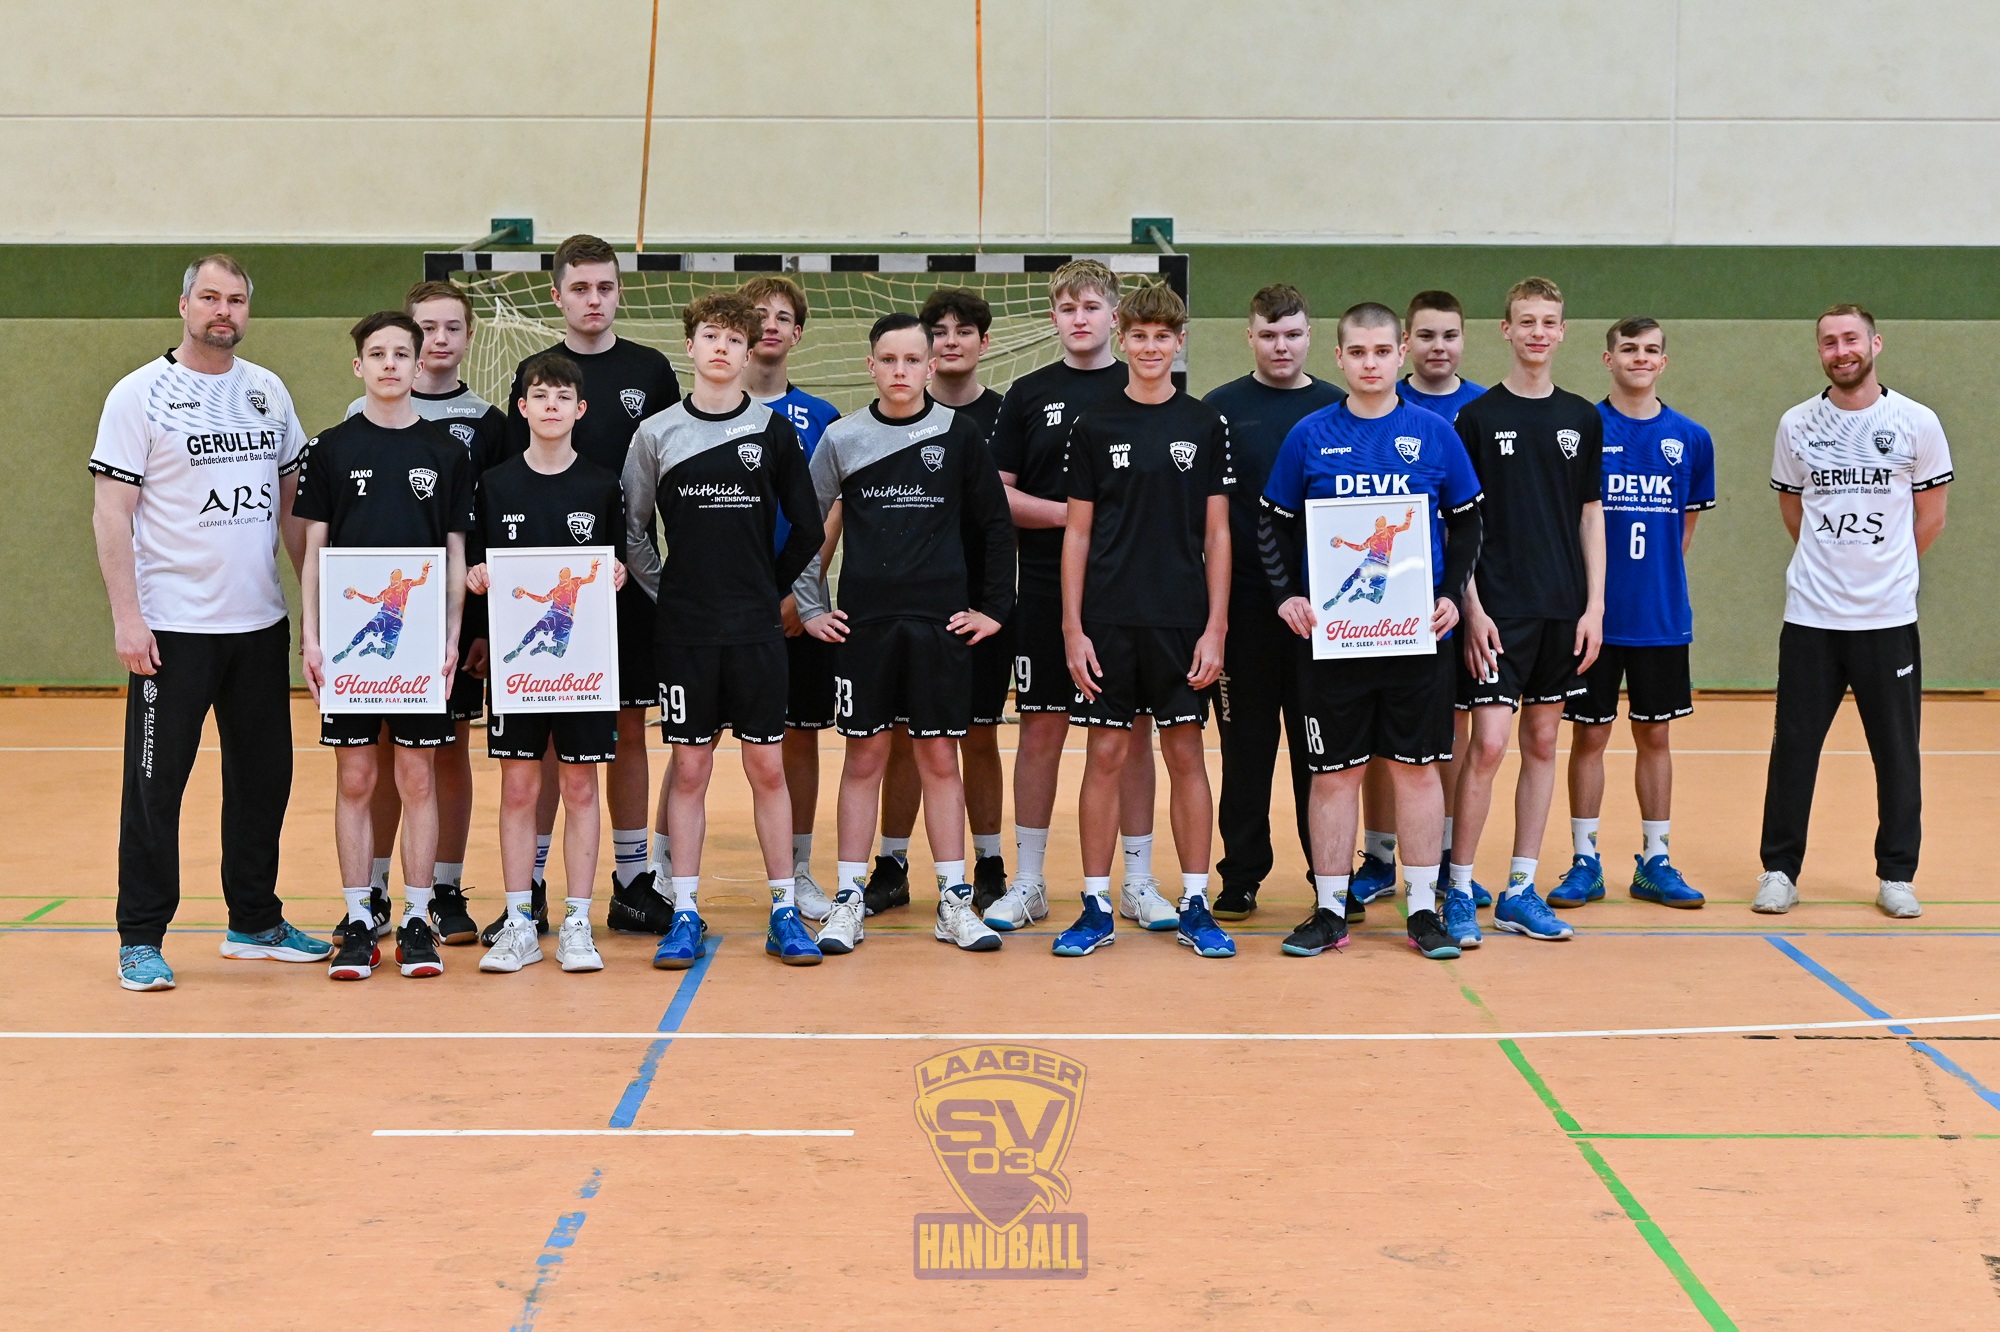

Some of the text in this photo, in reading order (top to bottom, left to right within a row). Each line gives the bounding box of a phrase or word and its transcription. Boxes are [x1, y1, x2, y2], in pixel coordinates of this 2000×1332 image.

[623, 396, 642, 405] SV
[1044, 402, 1065, 411] JAKO
[1047, 411, 1062, 426] 20
[725, 423, 756, 437] Kempa
[908, 424, 938, 440] Kempa
[1495, 431, 1517, 439] JAKO
[187, 431, 275, 455] GERULLAT
[1109, 444, 1131, 453] JAKO
[1399, 444, 1417, 452] SV
[1499, 440, 1514, 455] 14
[1561, 438, 1577, 447] SV
[1809, 440, 1836, 448] Kempa
[741, 451, 759, 459] SV
[1174, 450, 1192, 459] SV
[1320, 447, 1352, 455] Kempa
[190, 457, 234, 467] Dachdeckerei
[236, 454, 248, 462] und
[250, 453, 262, 461] Bau
[350, 470, 373, 479] JAKO
[1811, 468, 1892, 486] GERULLAT
[357, 479, 367, 496] 2
[413, 477, 434, 487] SV
[1336, 474, 1410, 496] DEVK
[1607, 474, 1672, 495] DEVK
[678, 484, 745, 498] Weitblick
[861, 485, 925, 498] Weitblick
[1608, 494, 1638, 502] Rostock
[199, 483, 272, 518] ARS
[502, 514, 525, 523] JAKO
[570, 521, 590, 530] SV
[1815, 512, 1885, 539] ARS
[509, 524, 517, 540] 3
[1630, 522, 1646, 560] 6
[1327, 617, 1420, 640] Handball
[334, 675, 431, 695] Handball
[507, 672, 604, 695] Handball
[146, 738, 154, 779] ELSNER
